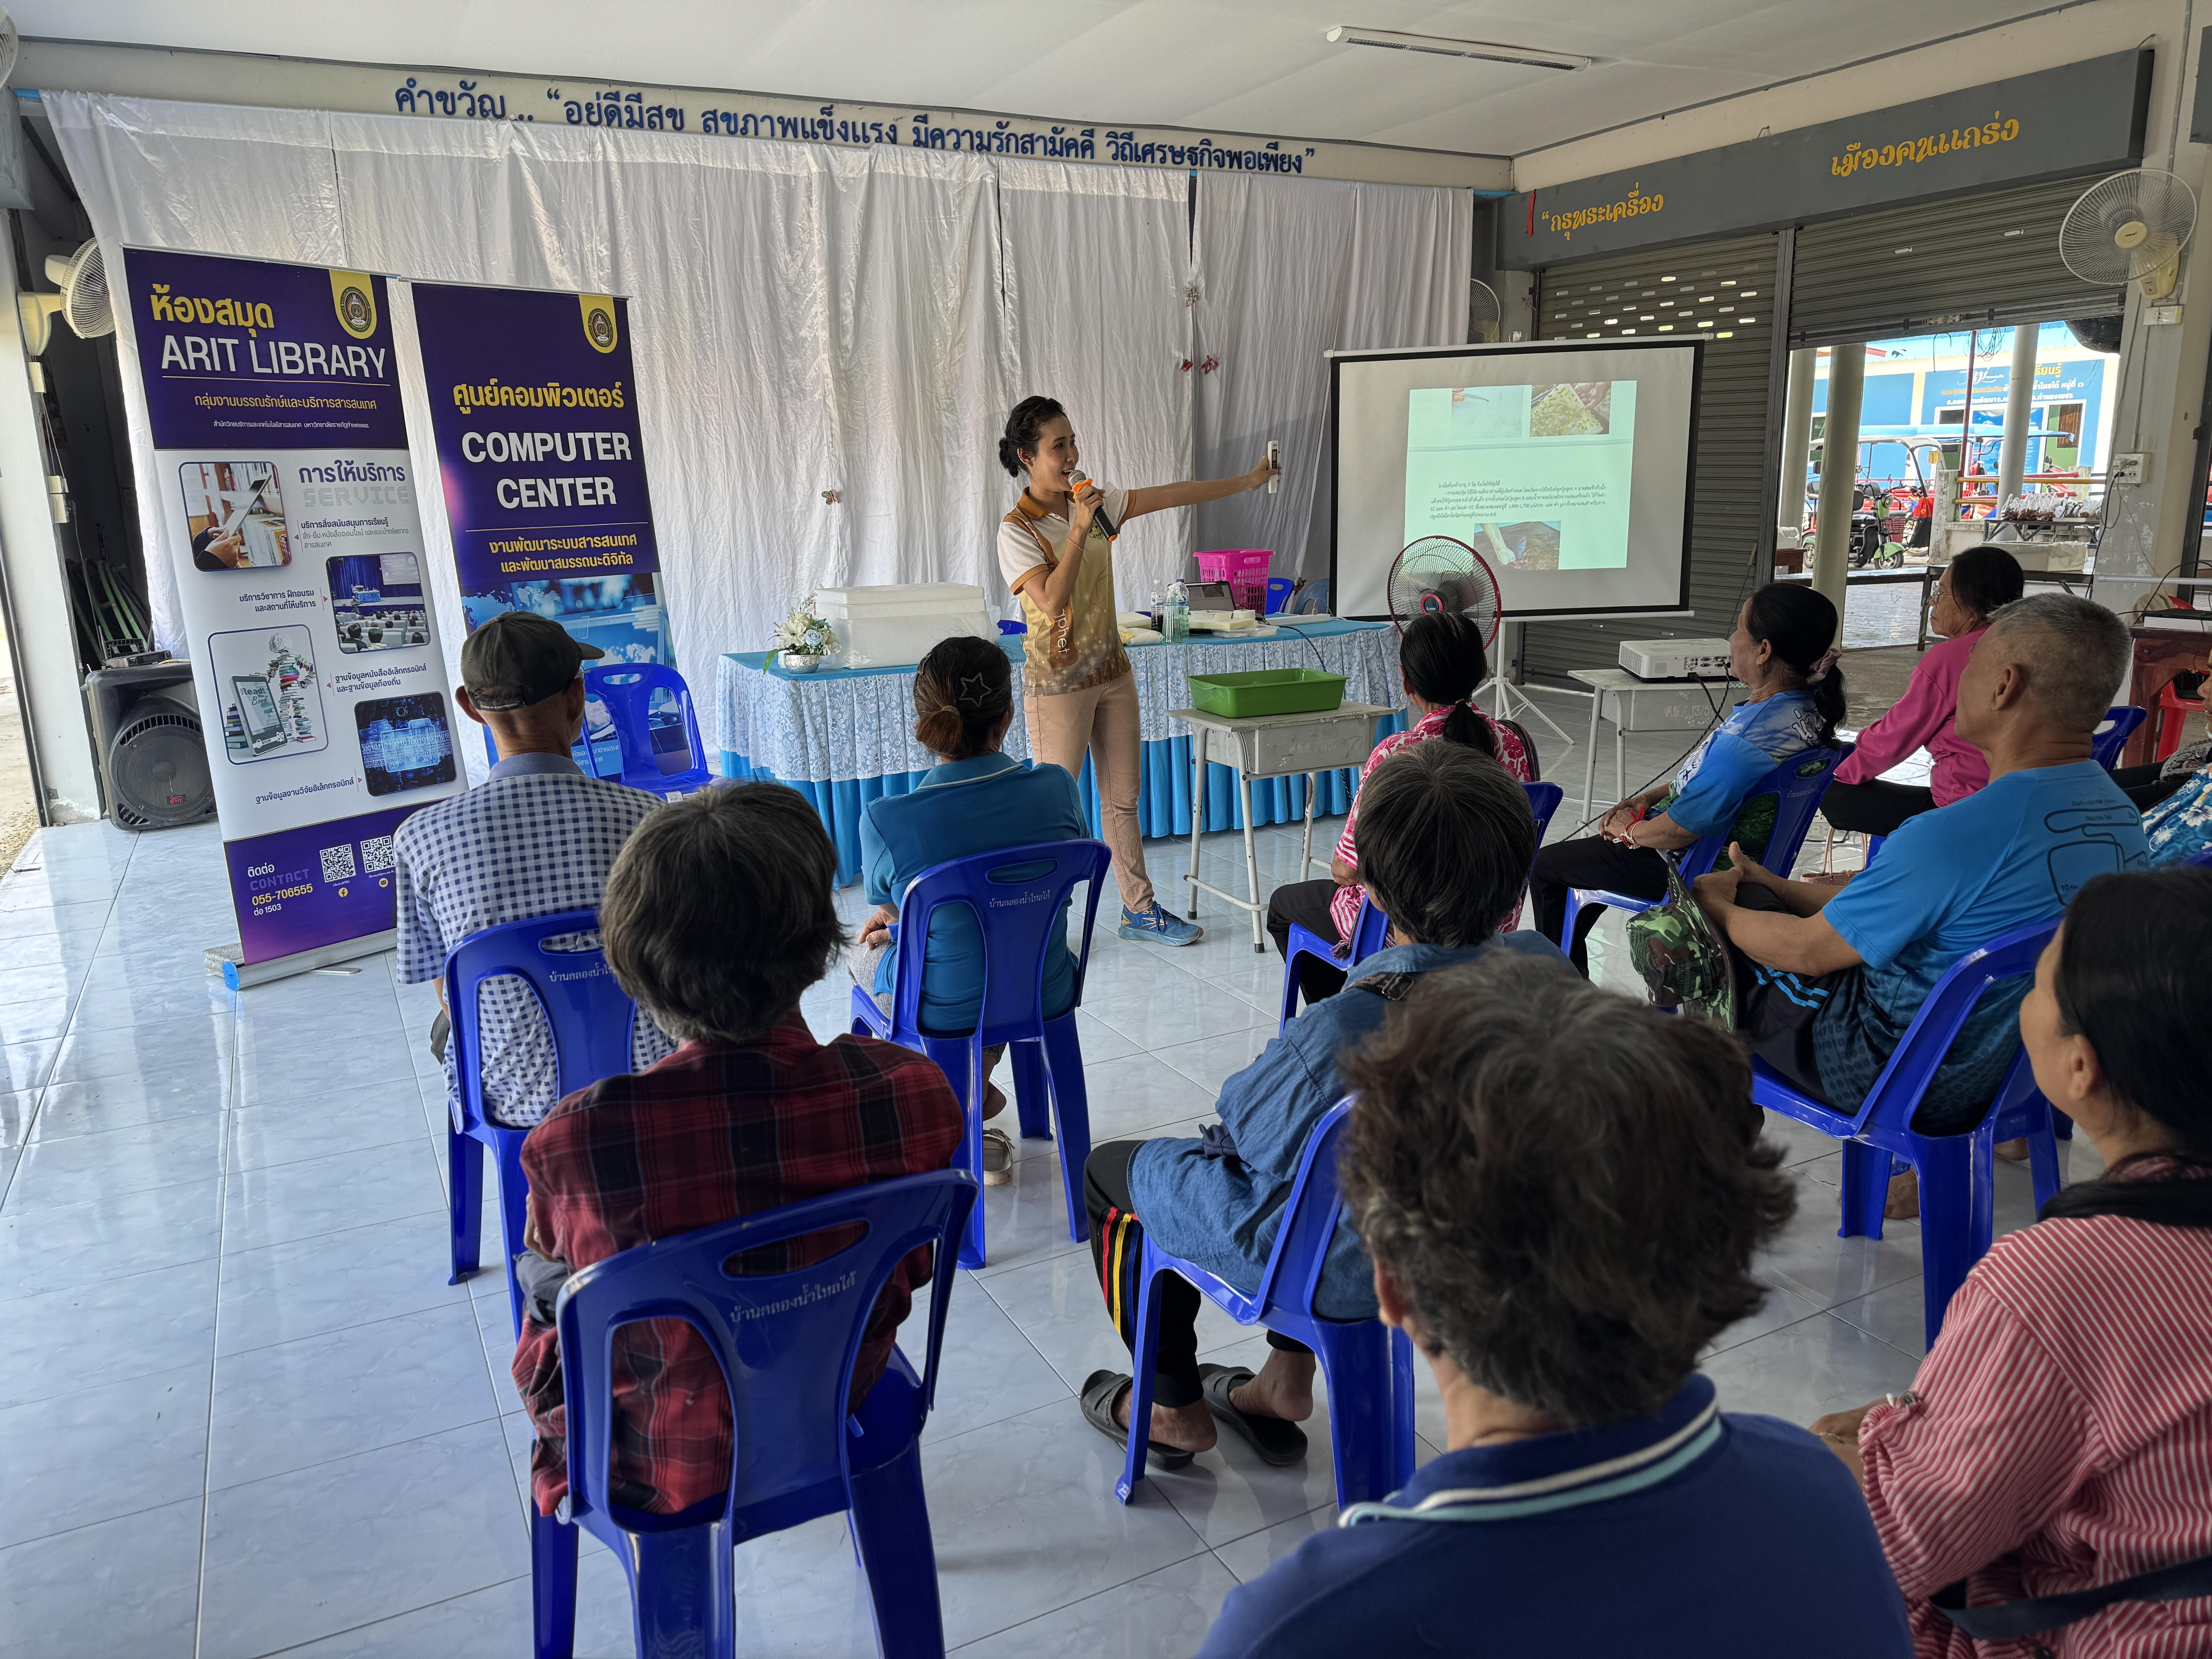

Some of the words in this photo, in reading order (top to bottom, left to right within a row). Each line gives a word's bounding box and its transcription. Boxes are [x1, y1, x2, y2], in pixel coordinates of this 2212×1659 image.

[912, 114, 1094, 159] มีความรักสามัคคี
[1832, 111, 2019, 177] เมืองคนแกร่ง
[150, 283, 274, 337] ห้องสมุด
[161, 335, 239, 373] ARIT
[249, 340, 385, 378] LIBRARY
[195, 393, 377, 410] กลุ่มงานบรรณรักษ์และบริการสารสนเทศ
[453, 378, 624, 414] ศูนย์คอมพิวเตอร์
[462, 432, 632, 462] COMPUTER
[299, 460, 405, 483] การให้บริการ
[303, 486, 409, 507] SERVICE
[496, 477, 617, 508] CENTER
[301, 517, 388, 528] บริการสิ่งสนับสนุนการเรียนรู้
[489, 534, 637, 553] งานพัฒนาระบบสารสนเทศ
[501, 551, 634, 573] และพัฒนาสมรรถนะดิจิทัล
[239, 592, 286, 601] บริการวิชาการ
[287, 589, 314, 598] ฝึกอบรม
[255, 599, 316, 612] และสถานที่ให้บริการ
[335, 663, 426, 683] ฐานข้อมูลหนังสืออิเล็กทรอนิกส์
[240, 687, 265, 696] Read!
[337, 677, 401, 692] และฐานข้อมูลท้องถิ่น
[252, 696, 269, 705] Book
[256, 776, 354, 804] ฐานข้อมูลงานวิจัยอิเล็กทรอนิกส์
[247, 862, 275, 878] ติดต่อ
[250, 869, 309, 891] CONTACT
[252, 883, 313, 905] 055-706555
[989, 890, 1051, 907] บ้านคลองน้ำไหลใต้
[254, 907, 263, 916] ต่อ
[265, 903, 282, 913] 1503
[730, 1271, 856, 1323] บ้านคลองน้ำไหลใต้
